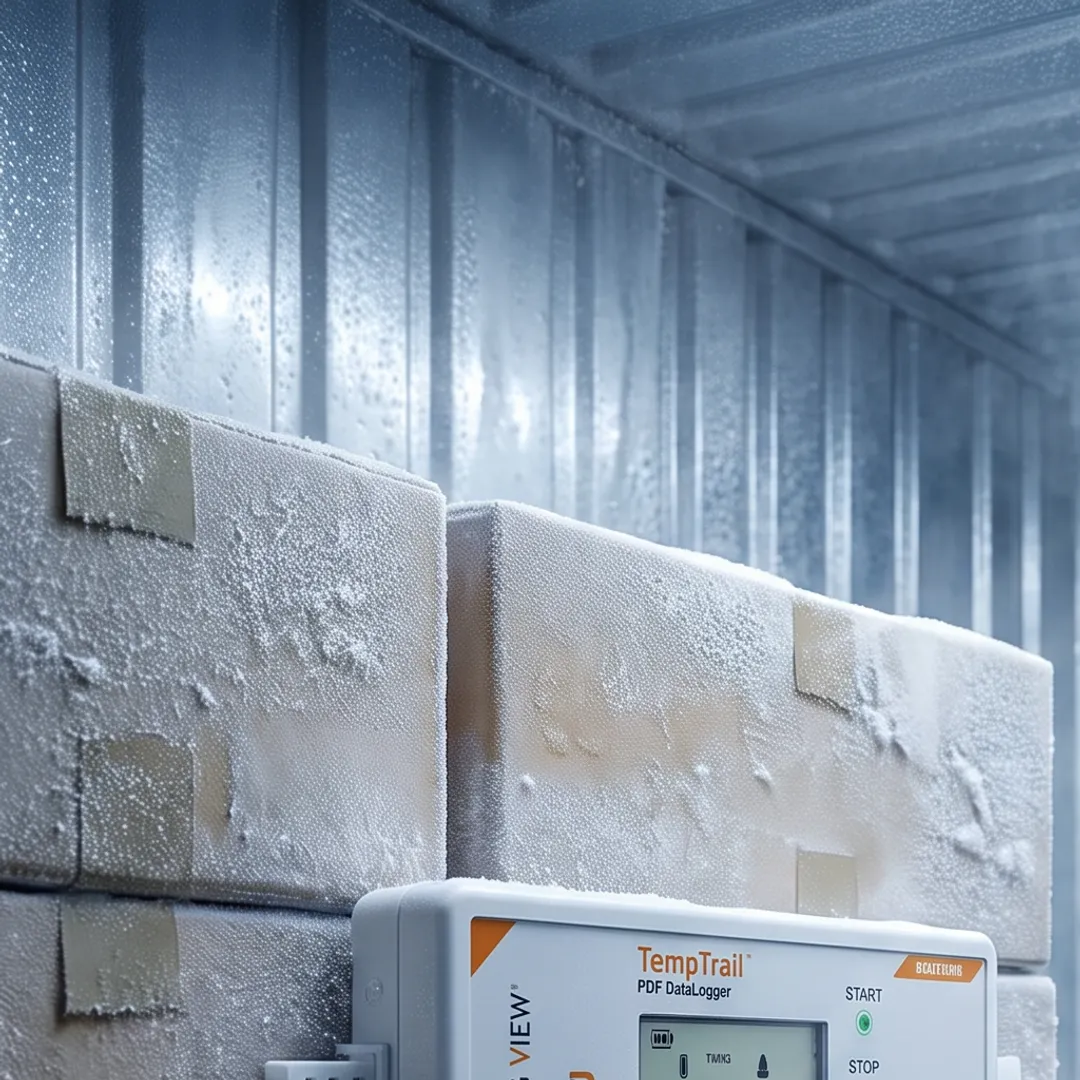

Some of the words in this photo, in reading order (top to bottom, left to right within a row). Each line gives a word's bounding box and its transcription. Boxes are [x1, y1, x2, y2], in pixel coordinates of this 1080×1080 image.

[637, 946, 743, 982] TempTrail
[637, 979, 662, 994] PDF
[665, 981, 732, 1001] DataLogger
[845, 985, 883, 1003] START
[848, 1059, 880, 1074] STOP
